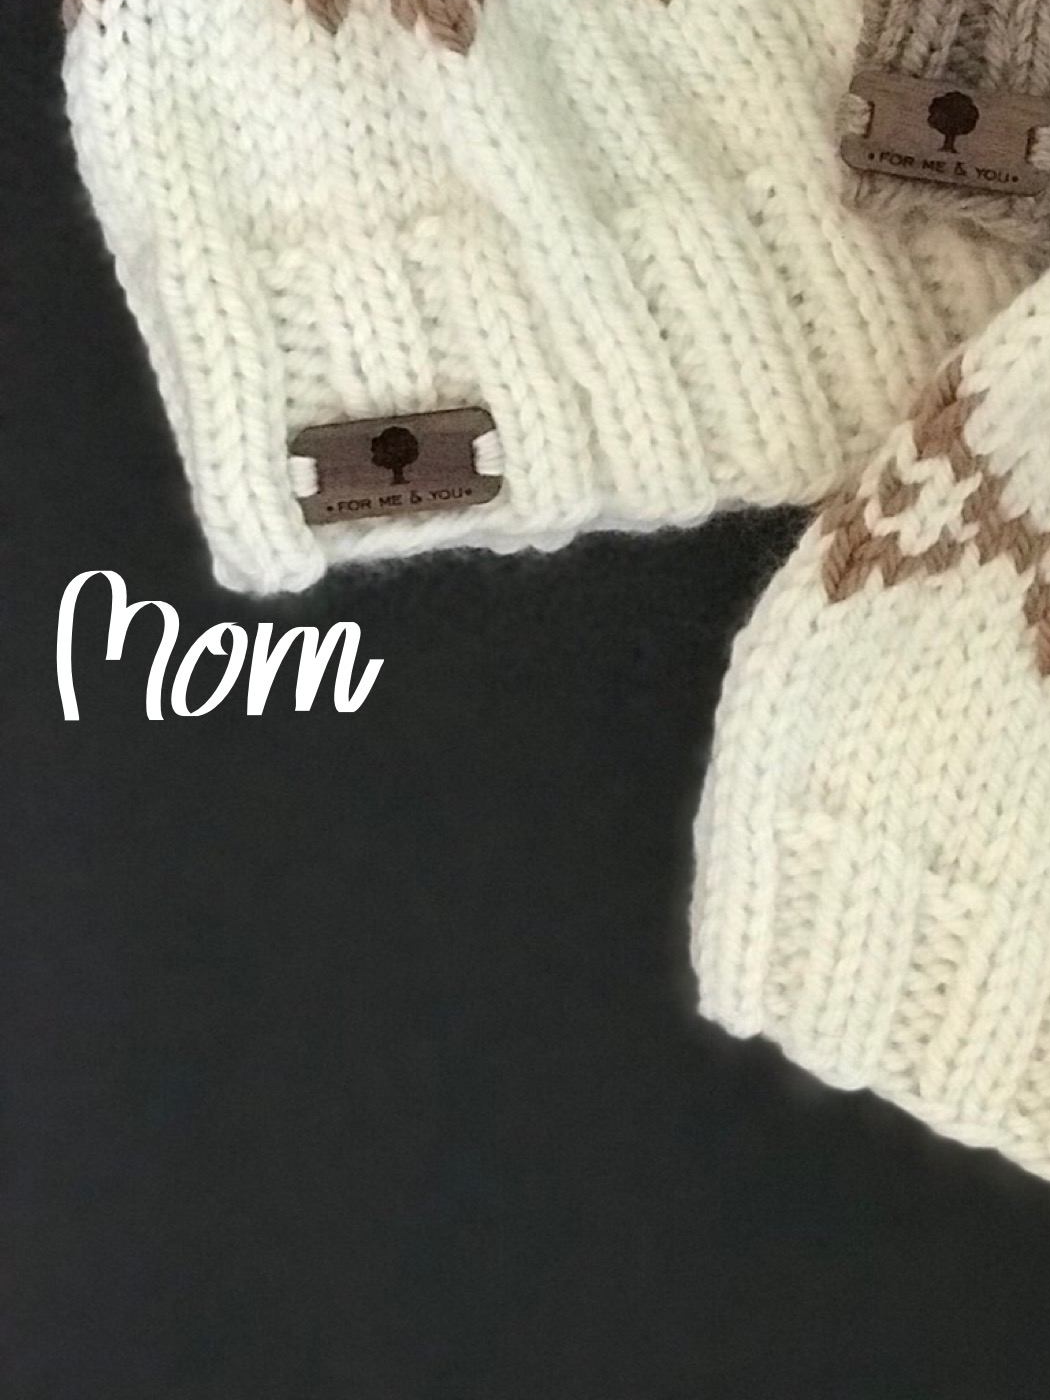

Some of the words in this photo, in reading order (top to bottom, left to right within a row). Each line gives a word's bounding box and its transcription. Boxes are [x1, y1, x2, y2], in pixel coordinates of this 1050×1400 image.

[879, 151, 915, 168] FOR
[922, 159, 946, 174] ME
[954, 161, 967, 176] &
[975, 166, 1010, 184] YOU
[338, 499, 372, 512] FOR
[378, 494, 403, 508] ME
[409, 490, 422, 504] &
[429, 487, 463, 501] YOU
